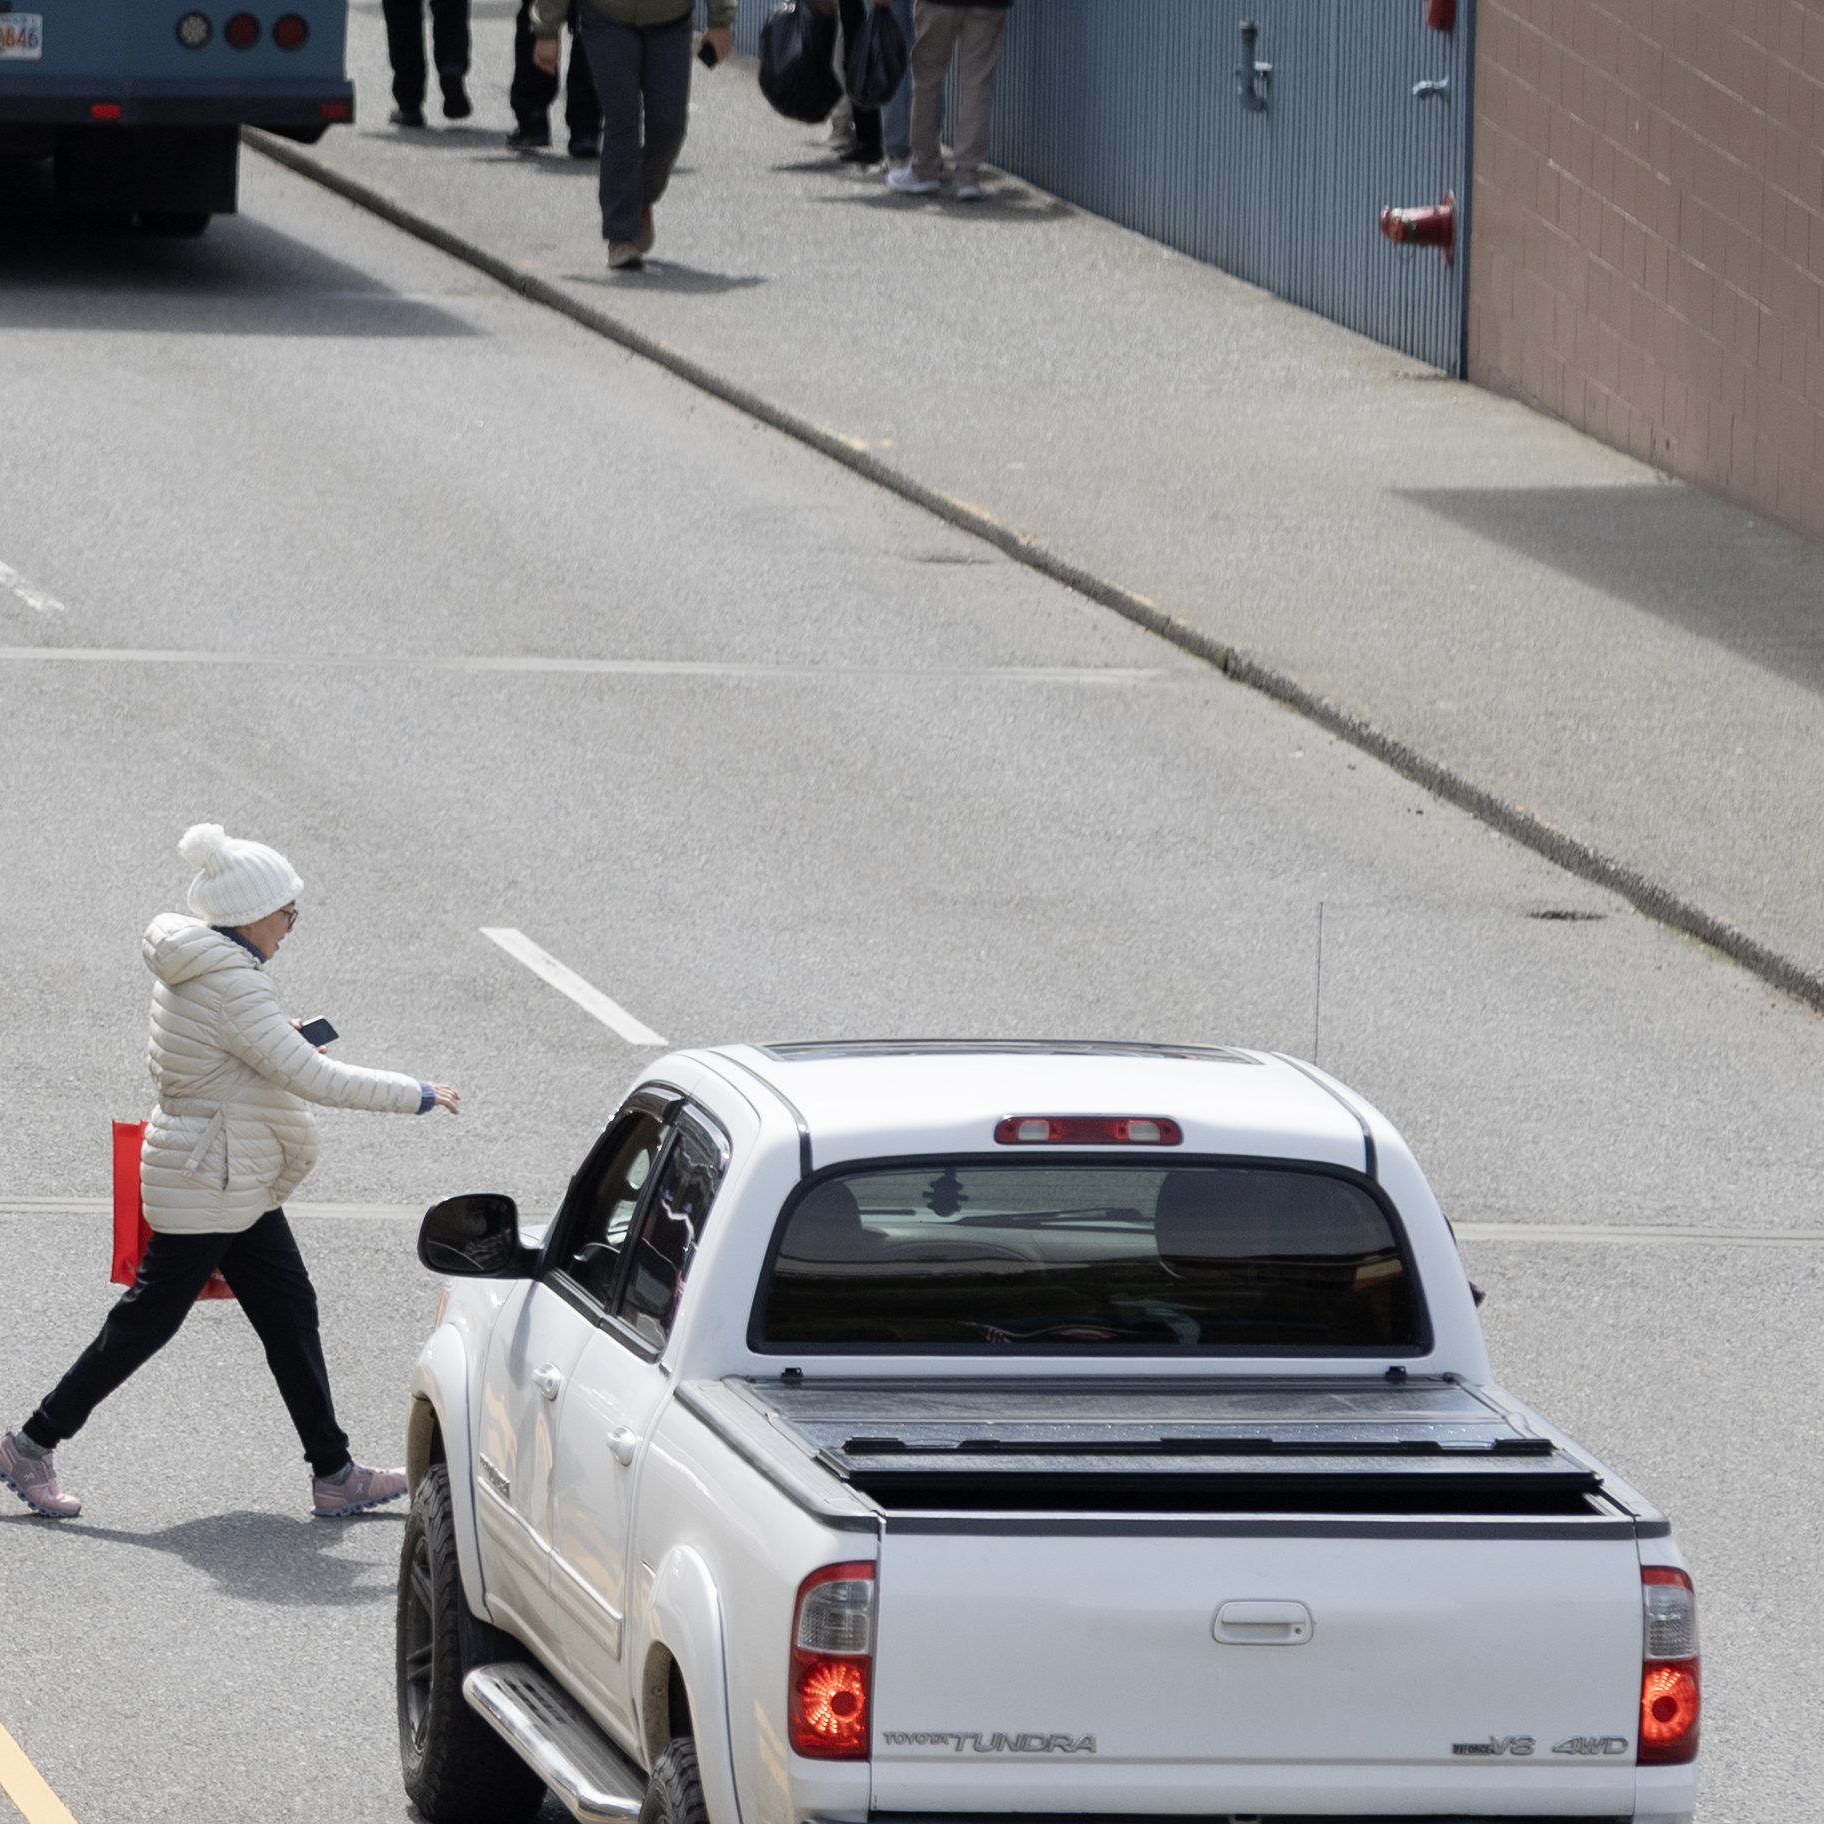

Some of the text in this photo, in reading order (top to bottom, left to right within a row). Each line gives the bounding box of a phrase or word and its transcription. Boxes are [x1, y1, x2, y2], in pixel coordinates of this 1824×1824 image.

[882, 1731, 1097, 1753] TOYOTA TUNDRA
[1489, 1734, 1537, 1756] V8
[1551, 1735, 1630, 1755] 4WD
